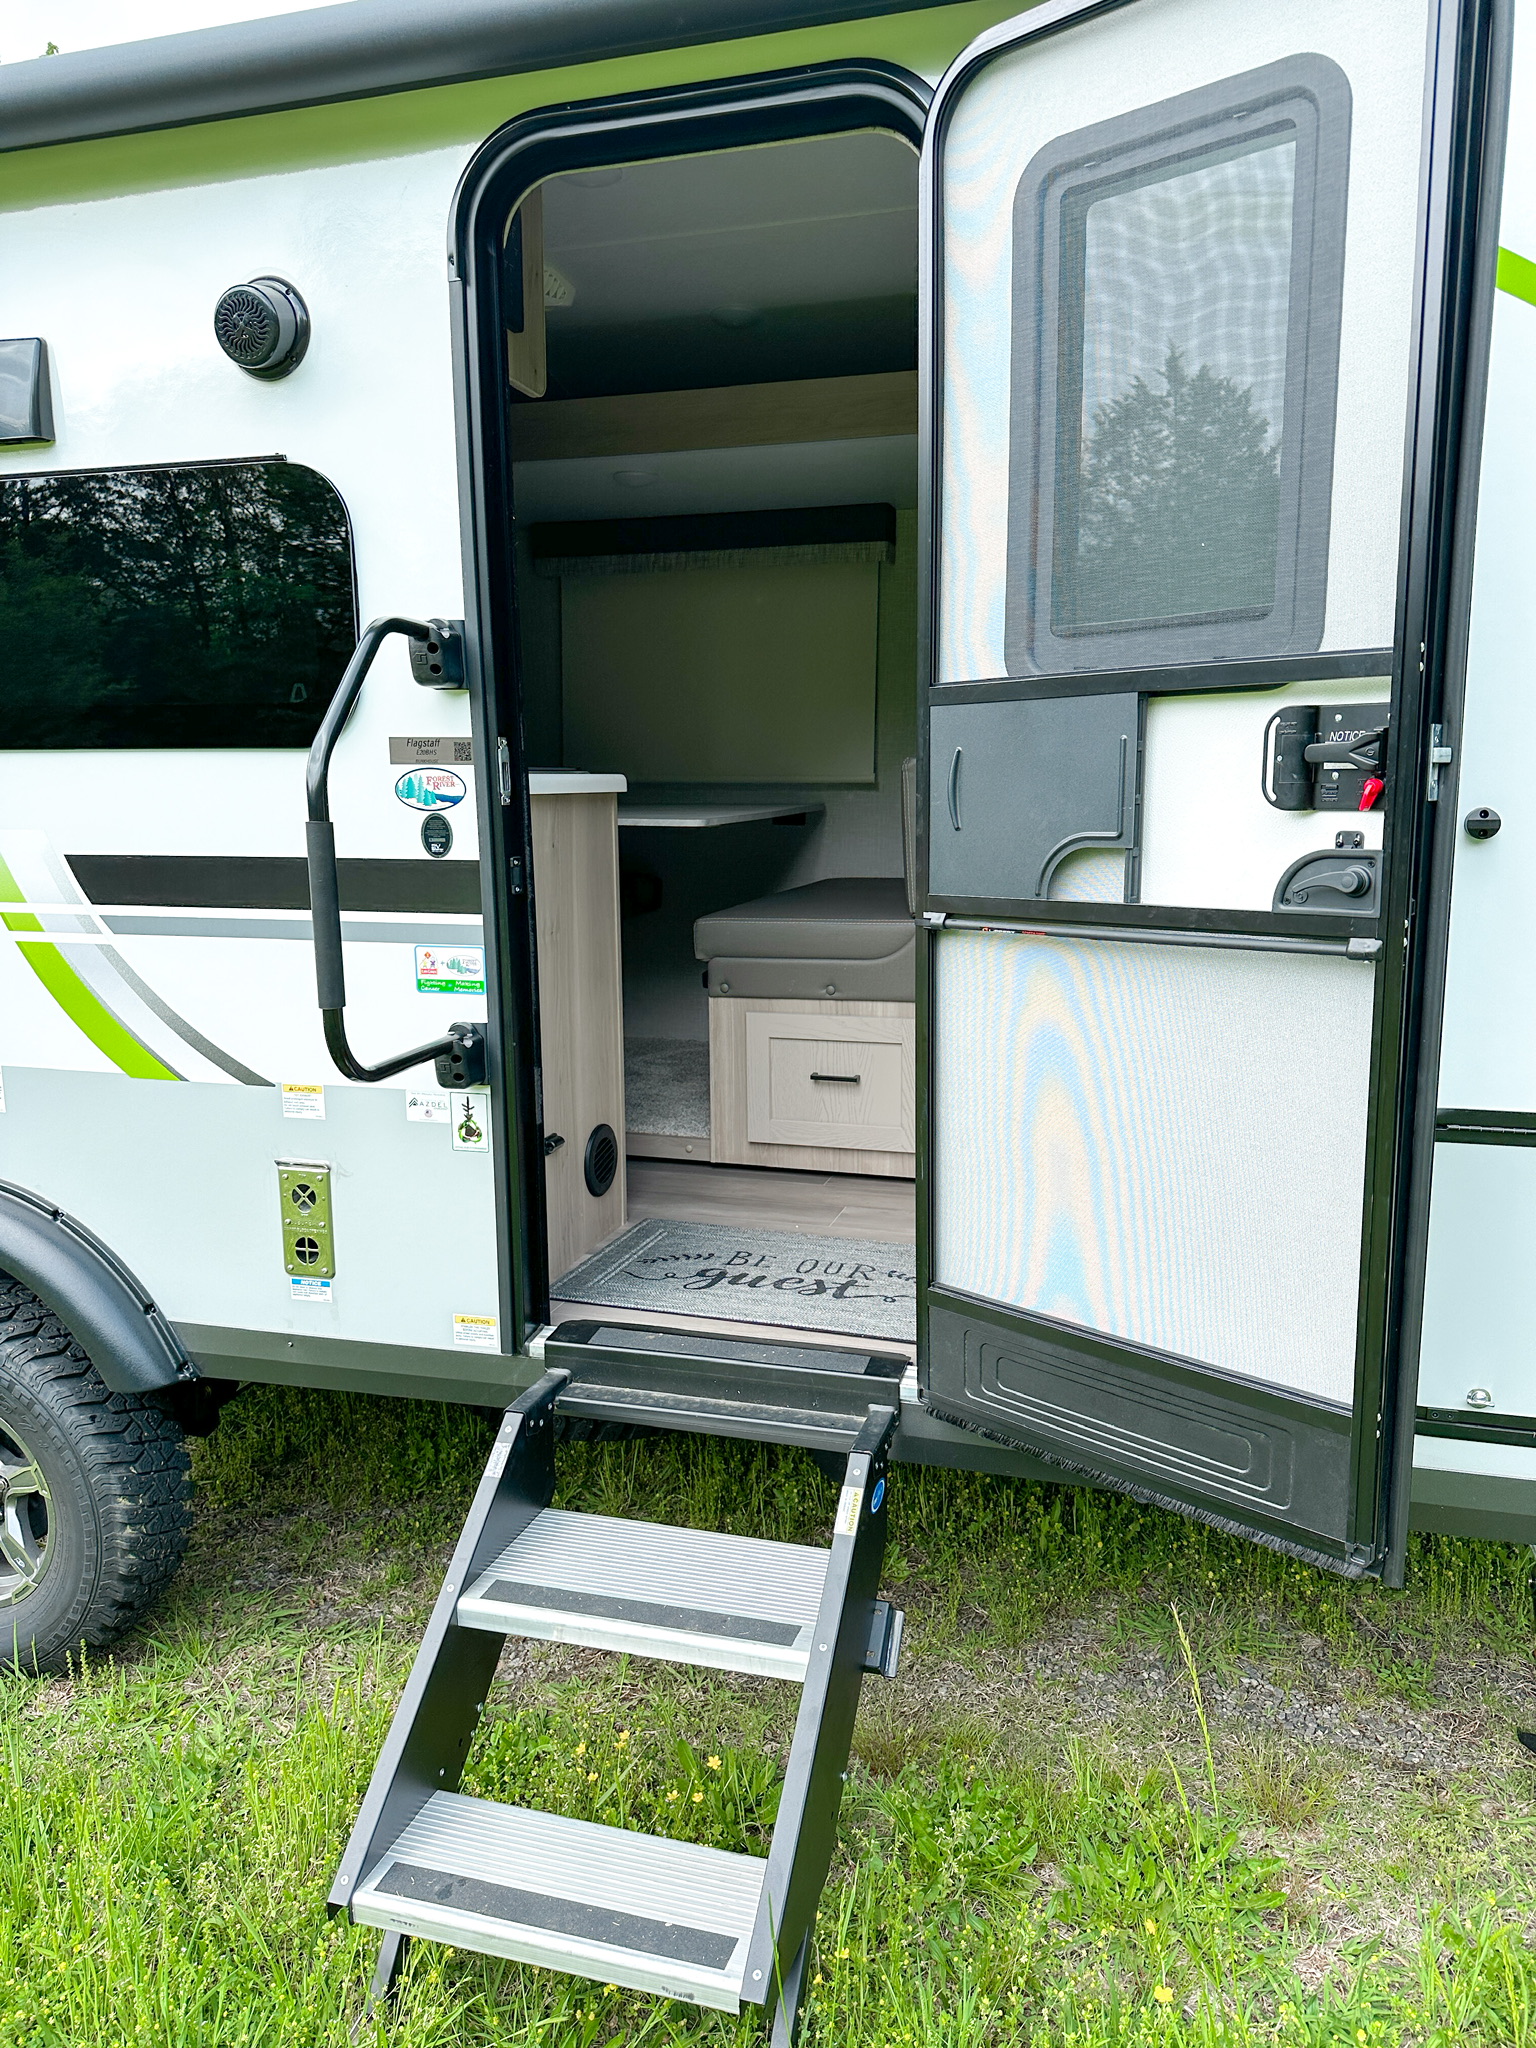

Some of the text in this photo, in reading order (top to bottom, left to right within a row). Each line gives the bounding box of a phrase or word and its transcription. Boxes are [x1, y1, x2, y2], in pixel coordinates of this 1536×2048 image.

[406, 738, 441, 749] Flagstaff
[426, 775, 454, 786] FOREST
[432, 781, 456, 790] RIVER
[726, 1250, 880, 1281] BE OUR
[300, 1279, 322, 1287] NOTICE
[680, 1267, 880, 1300] guest
[847, 1498, 859, 1531] CAUTION
